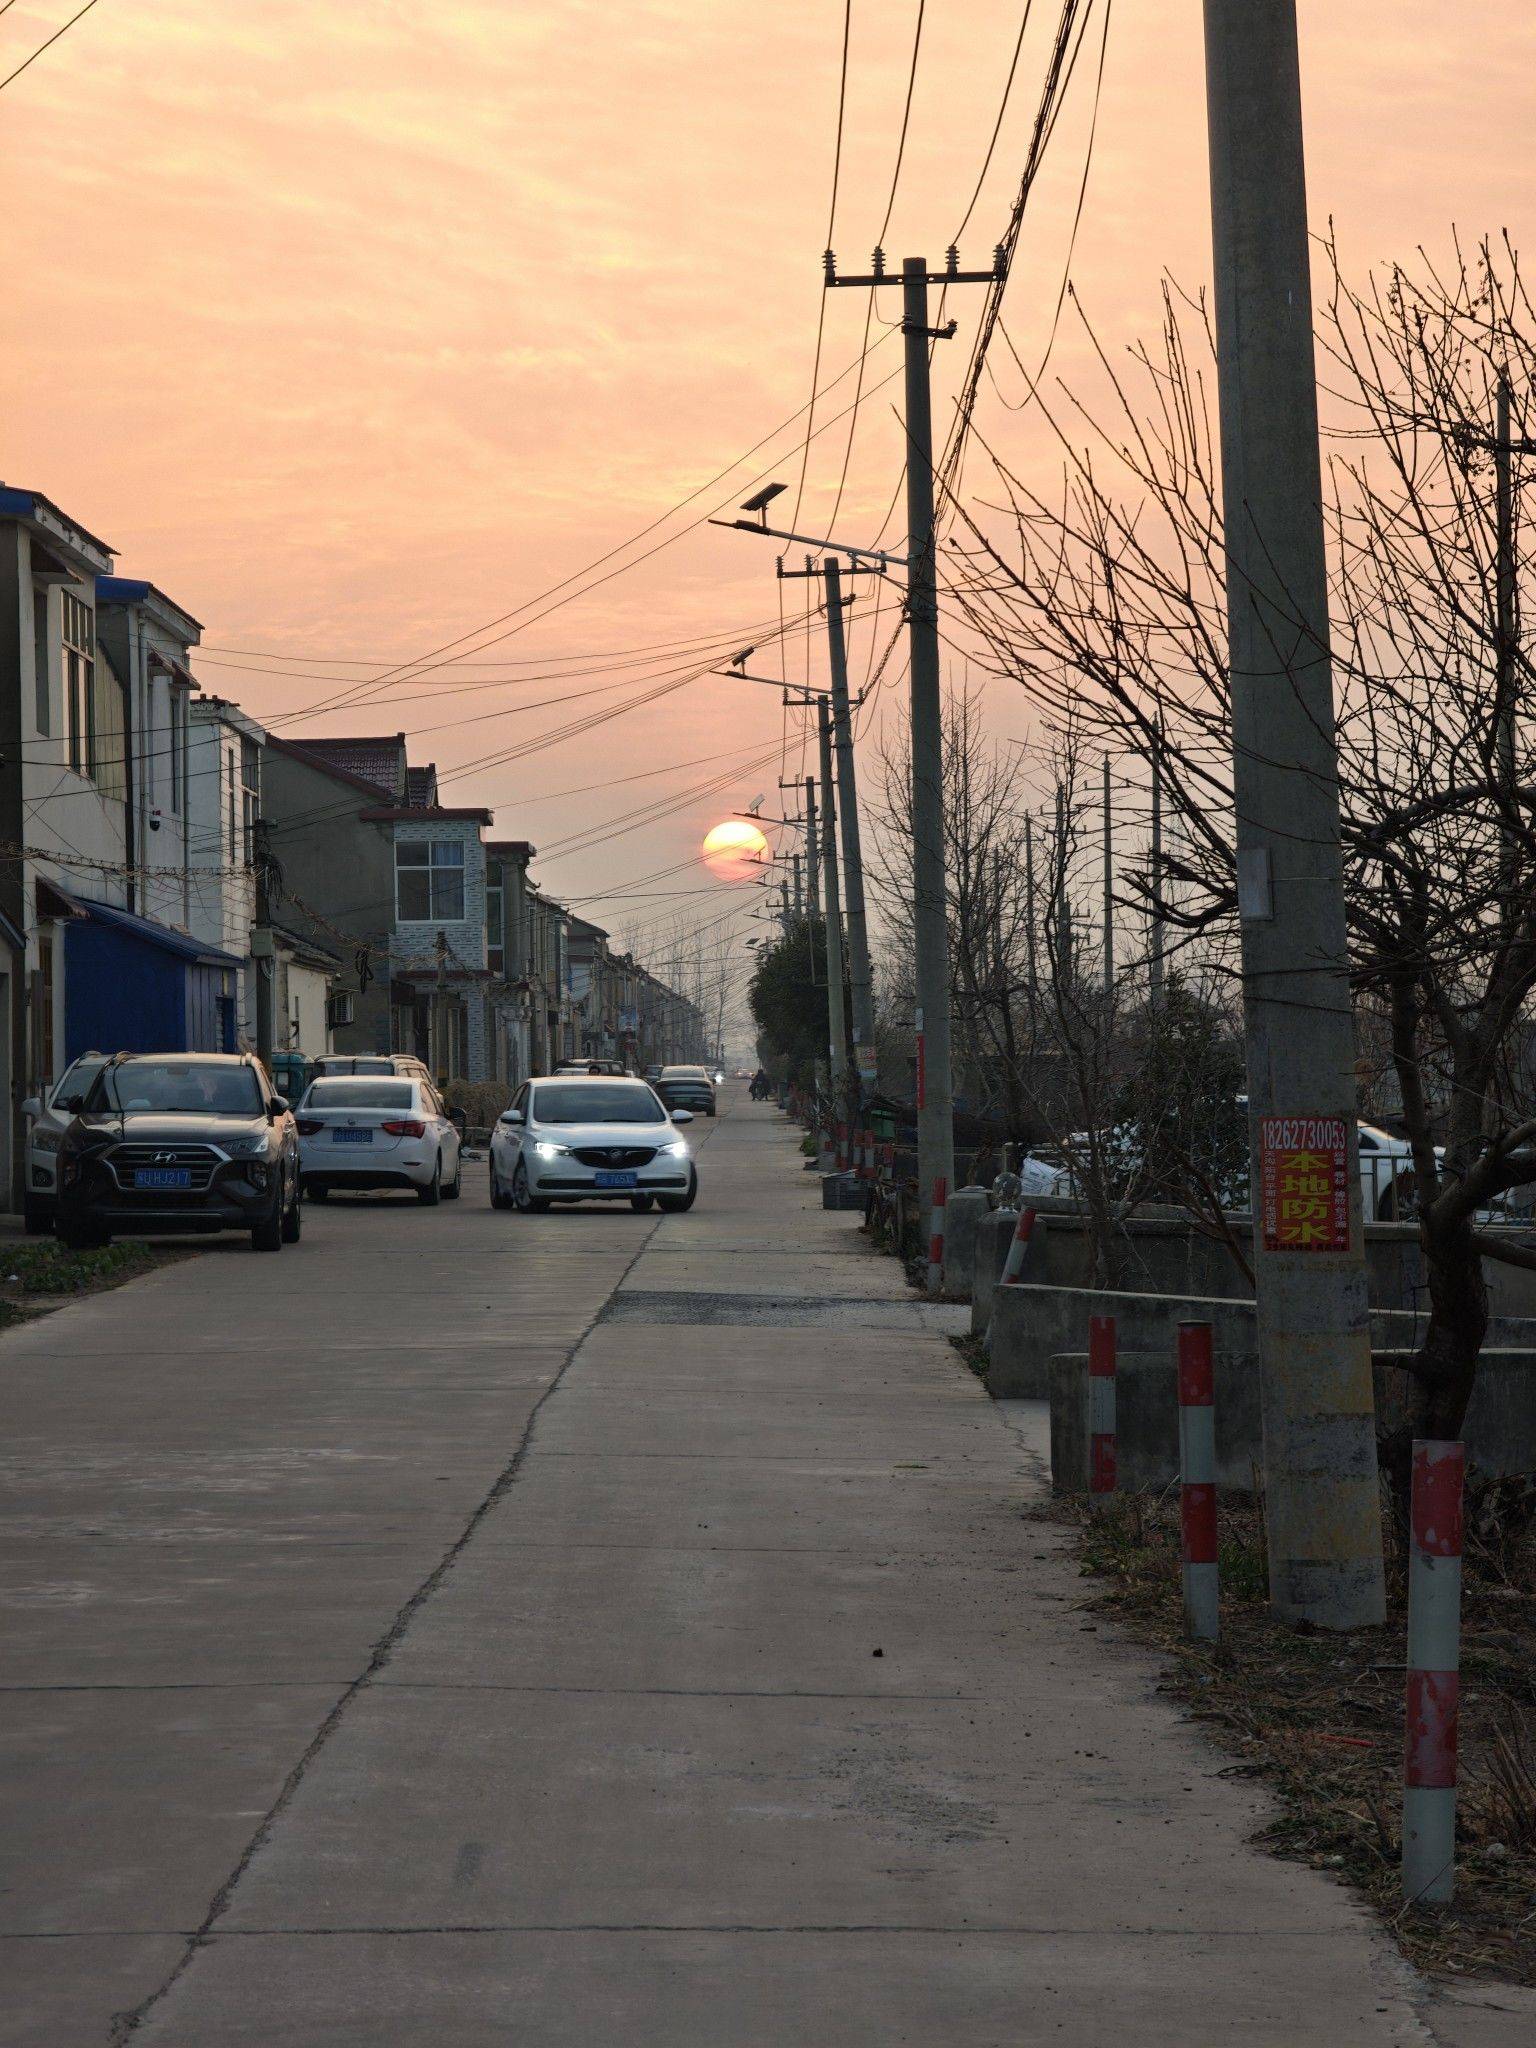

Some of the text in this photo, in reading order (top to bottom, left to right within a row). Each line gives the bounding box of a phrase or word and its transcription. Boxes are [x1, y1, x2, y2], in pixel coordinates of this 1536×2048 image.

[1262, 1119, 1346, 1150] 18262730053
[1280, 1150, 1331, 1243] 本地防水
